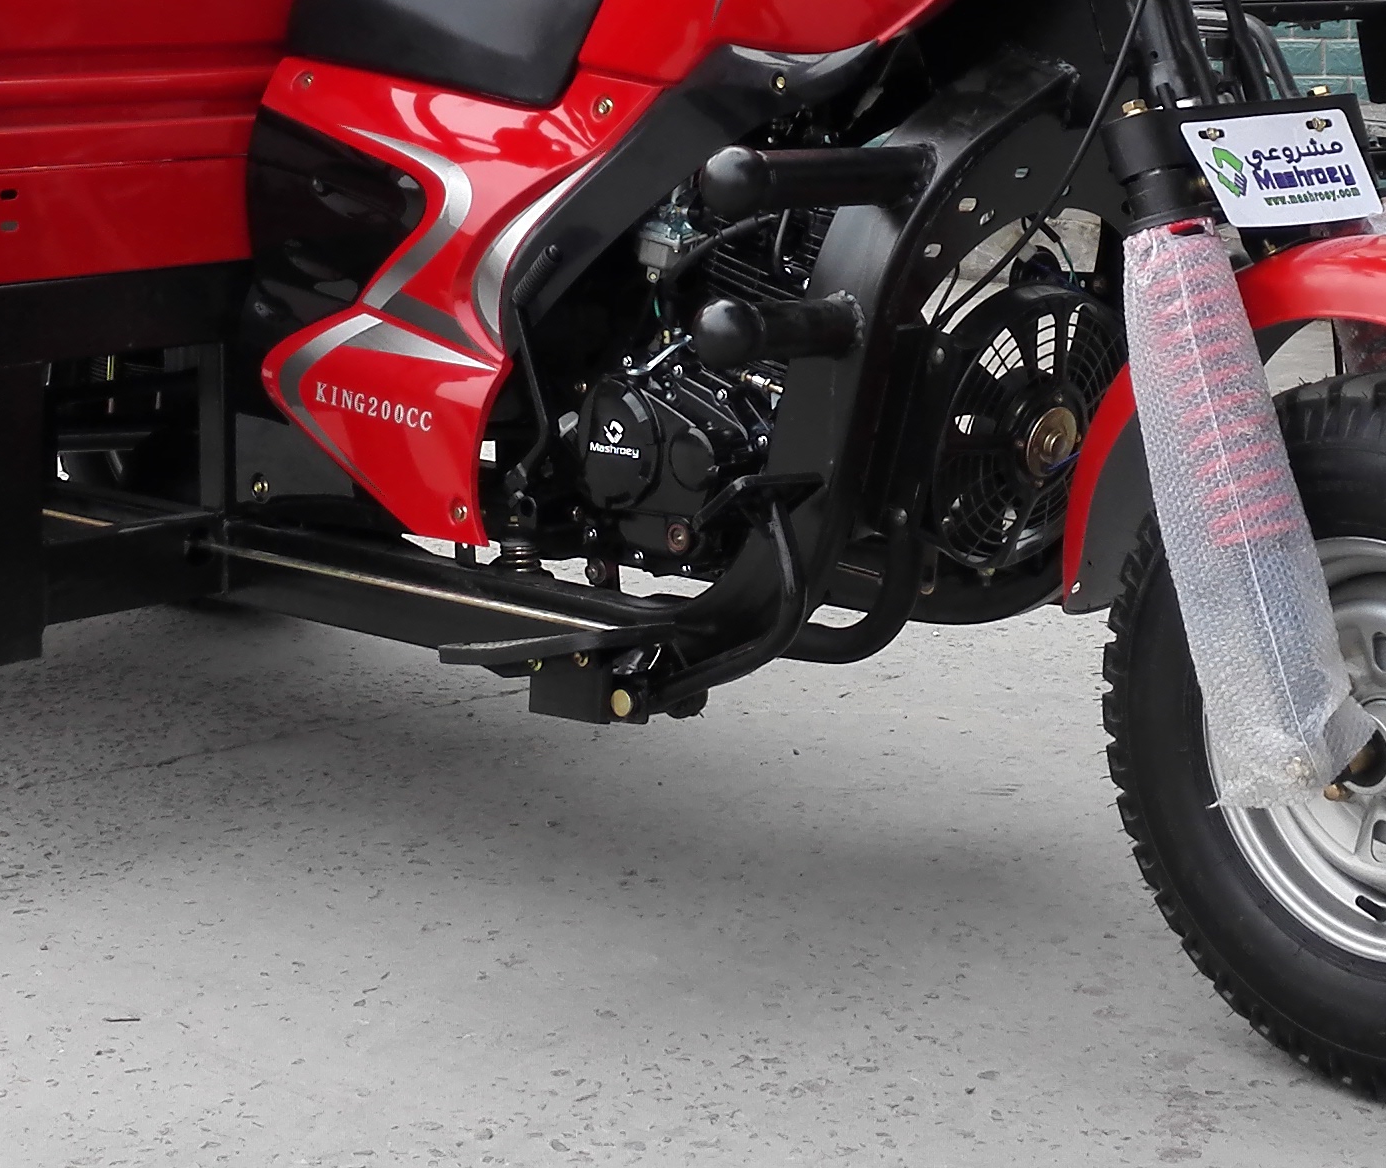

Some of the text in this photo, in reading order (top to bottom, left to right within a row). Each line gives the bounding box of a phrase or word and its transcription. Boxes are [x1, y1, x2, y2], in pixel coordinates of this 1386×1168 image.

[1244, 138, 1344, 169] مشروعي
[1251, 163, 1357, 191] Mashroey
[1263, 187, 1362, 206] www.mashroey.com
[315, 381, 433, 432] KING200CC
[589, 441, 640, 459] Mashroey
